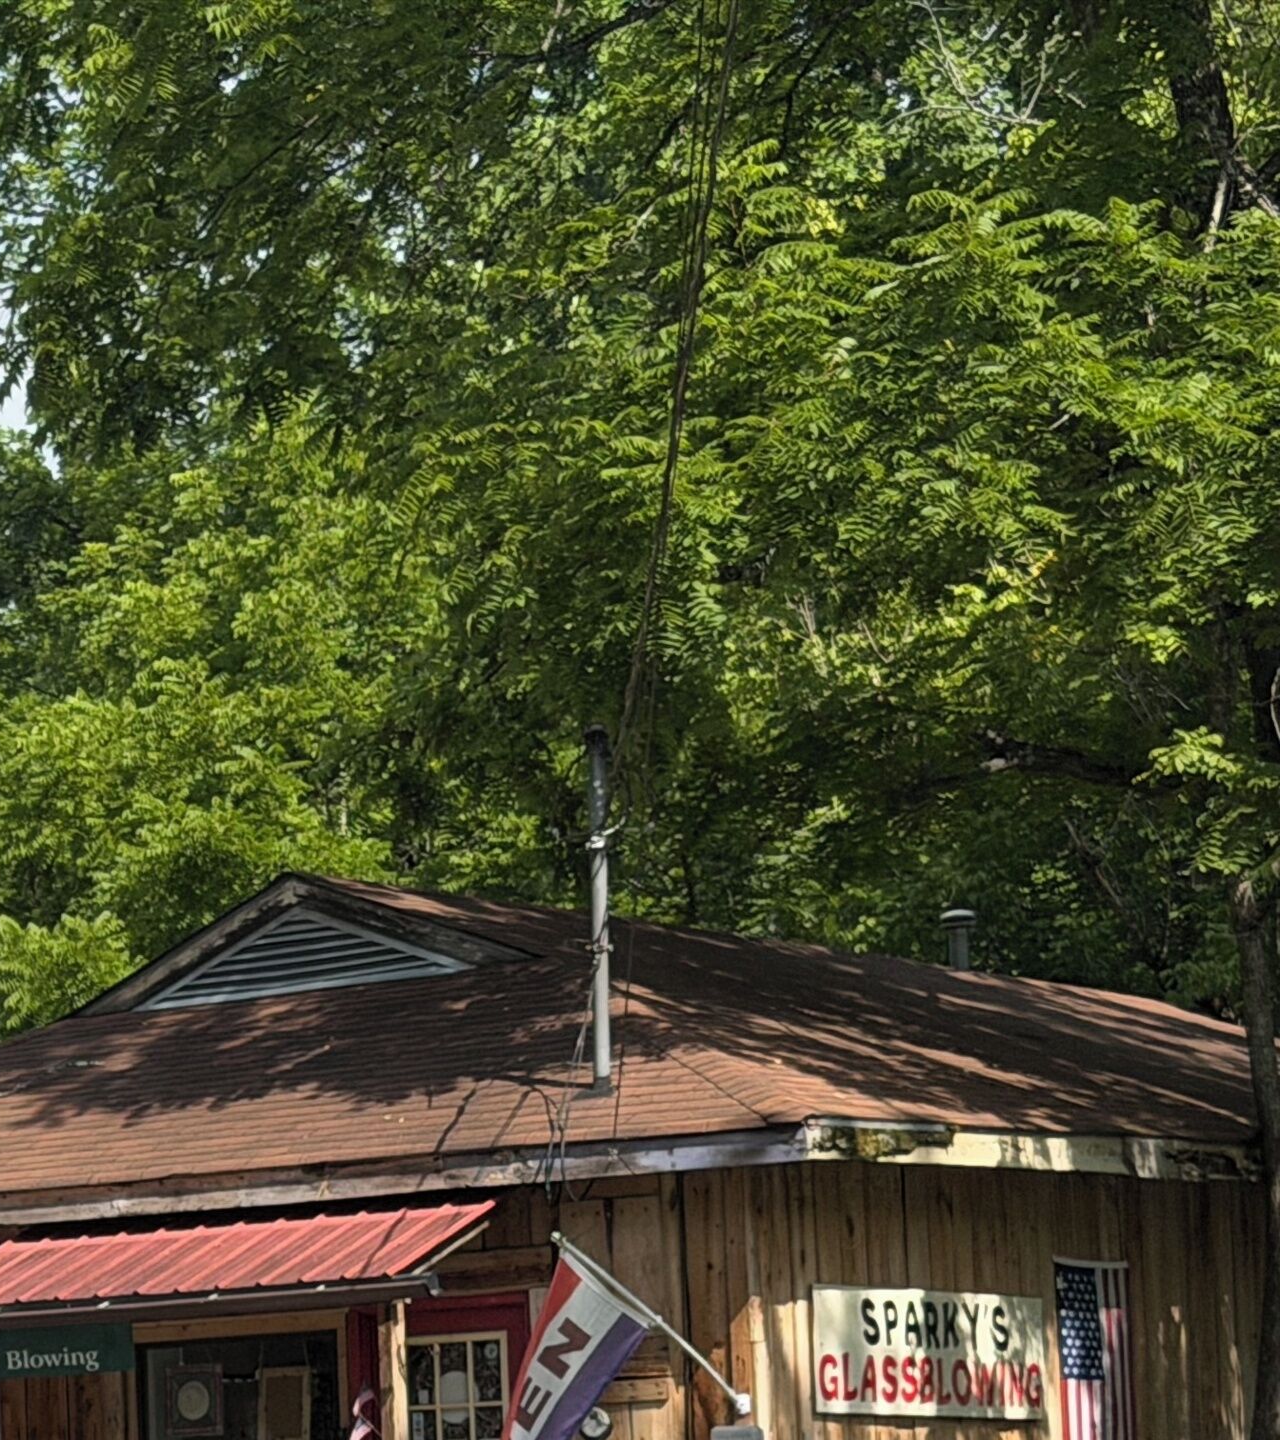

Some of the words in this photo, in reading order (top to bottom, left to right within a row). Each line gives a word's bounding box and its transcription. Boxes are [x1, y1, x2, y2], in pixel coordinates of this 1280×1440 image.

[860, 1298, 1010, 1352] SPARKY'S
[6, 1346, 101, 1372] Blowing
[819, 1352, 1042, 1409] GLASSBLOWING
